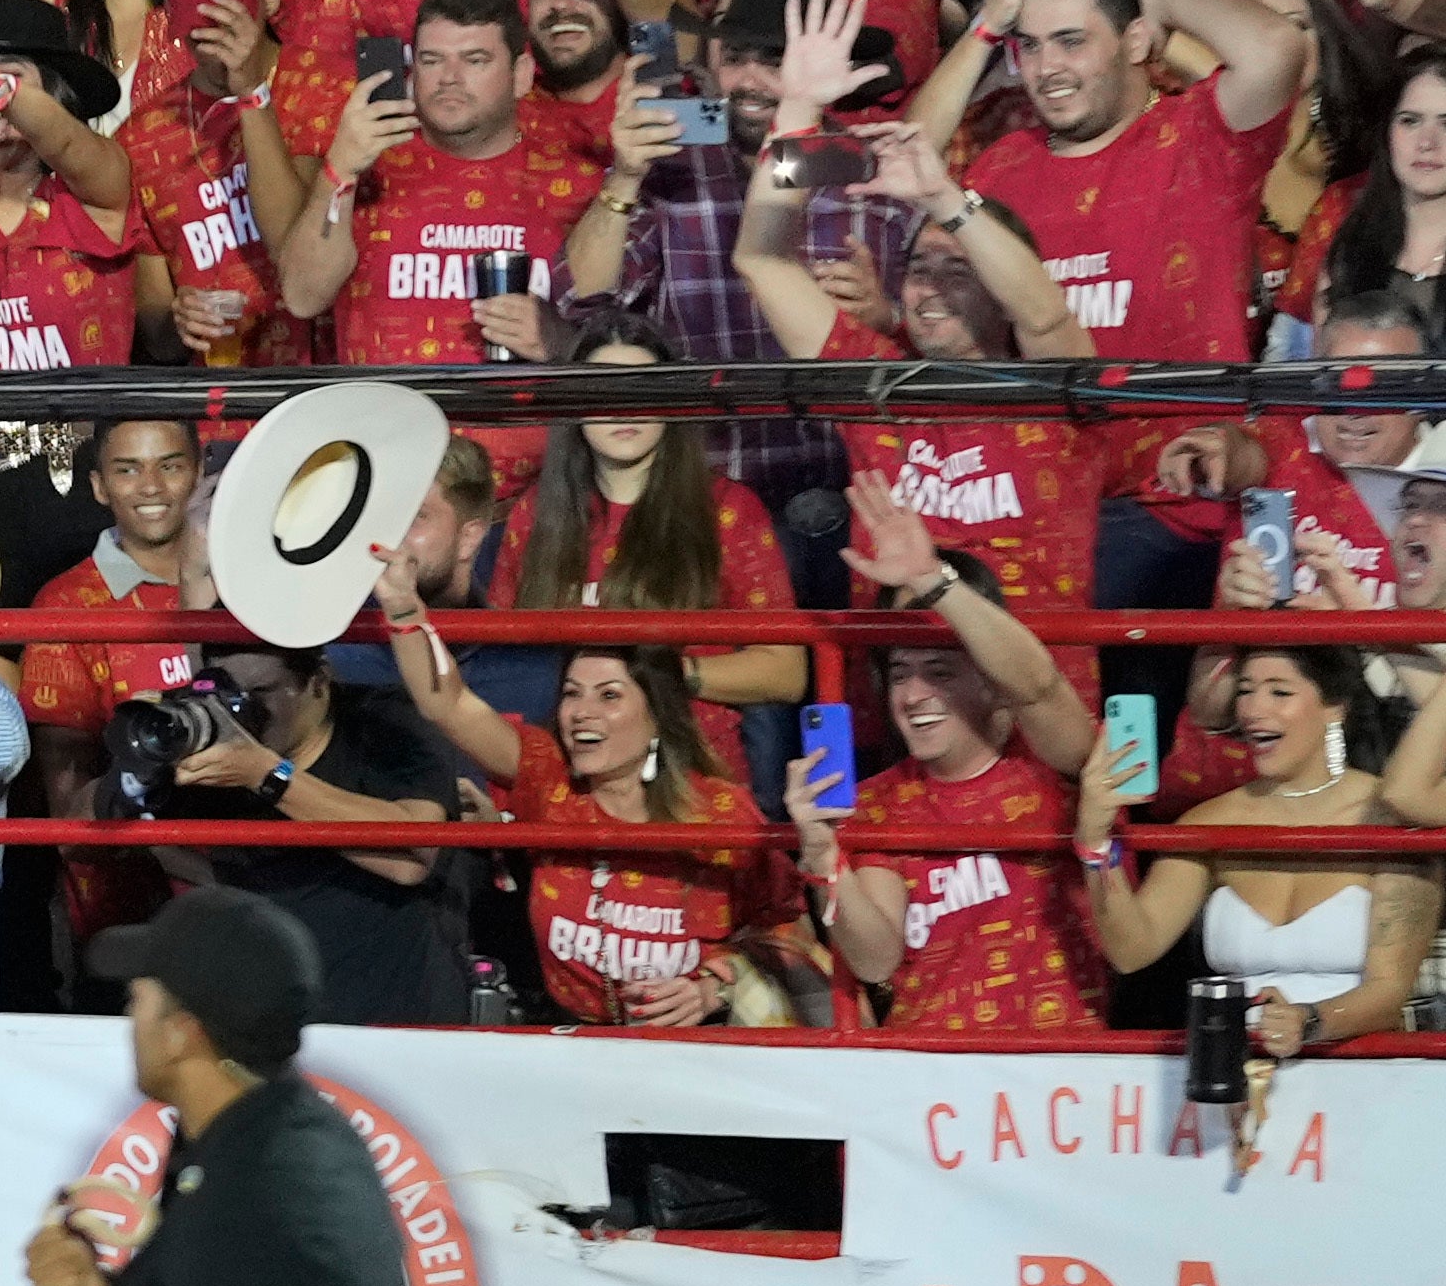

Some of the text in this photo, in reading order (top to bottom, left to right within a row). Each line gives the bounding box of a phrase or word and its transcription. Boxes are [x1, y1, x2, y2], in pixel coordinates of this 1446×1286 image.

[420, 223, 526, 251] CAMAROTE
[388, 252, 552, 301] BRAA
[925, 1084, 1326, 1183] CACHAA
